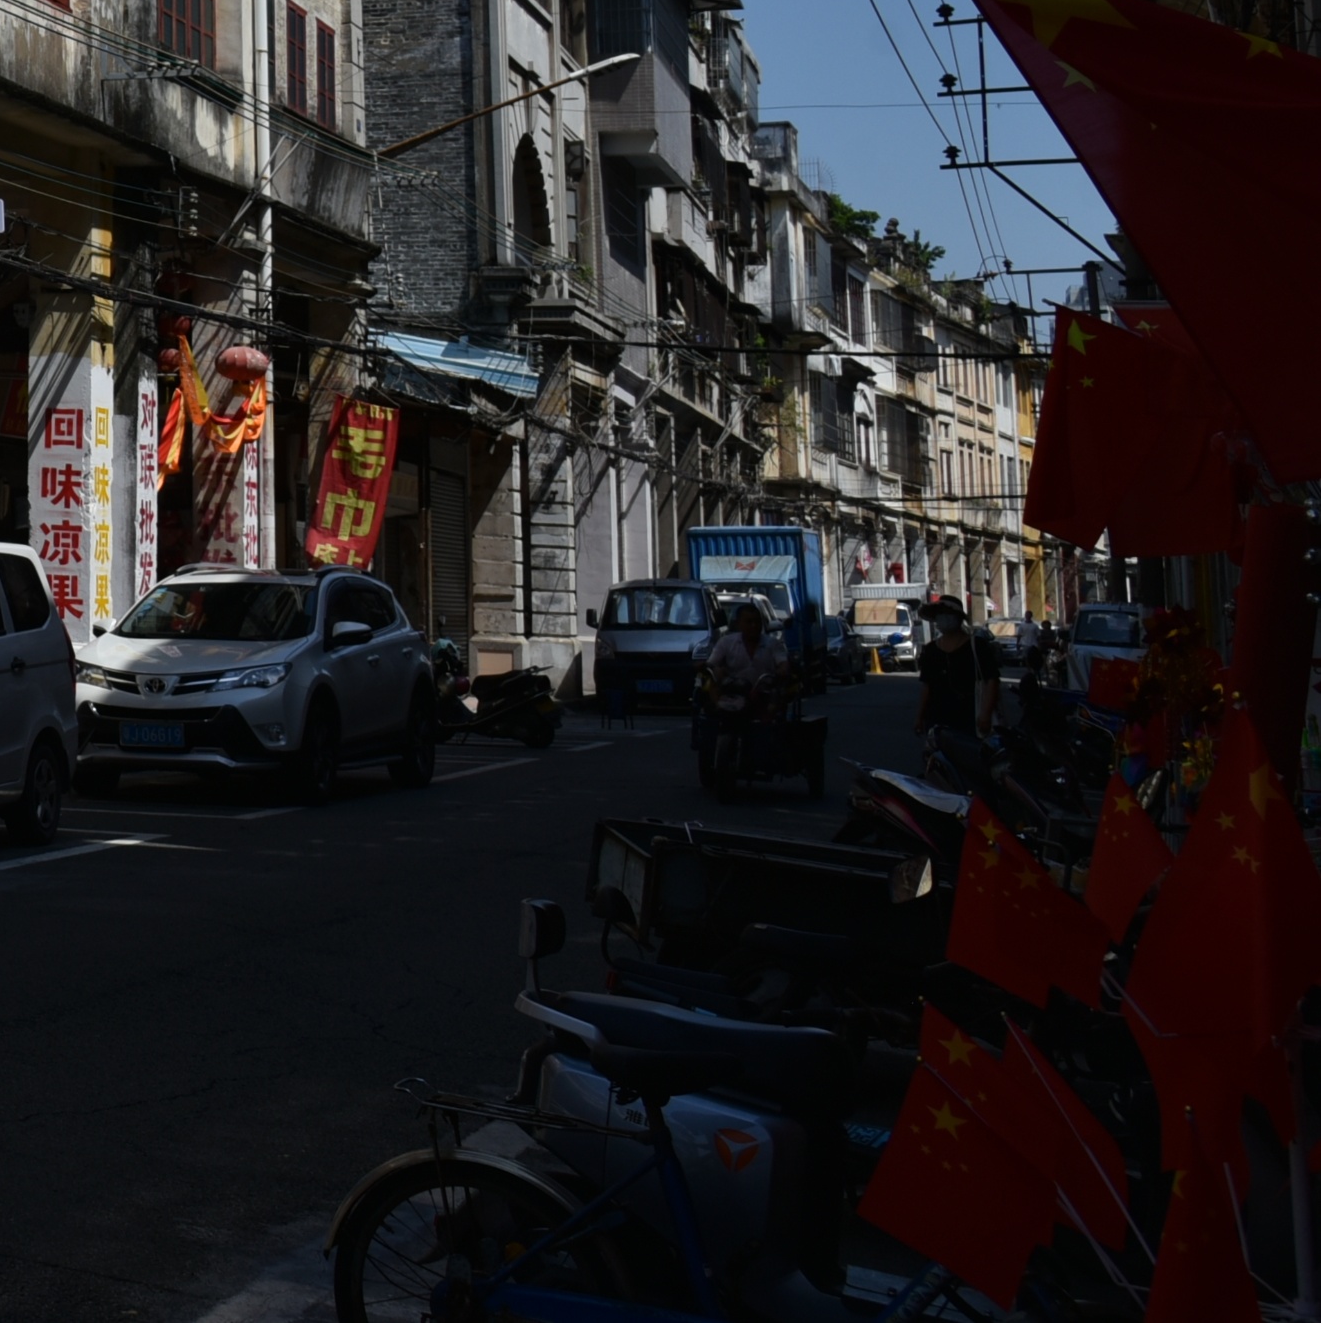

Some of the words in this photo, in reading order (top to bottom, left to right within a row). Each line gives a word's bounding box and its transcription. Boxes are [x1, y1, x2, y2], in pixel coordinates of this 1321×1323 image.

[39, 408, 84, 619] 回味凉果
[94, 406, 110, 619] 回味凉果
[139, 393, 156, 595] 对联批发
